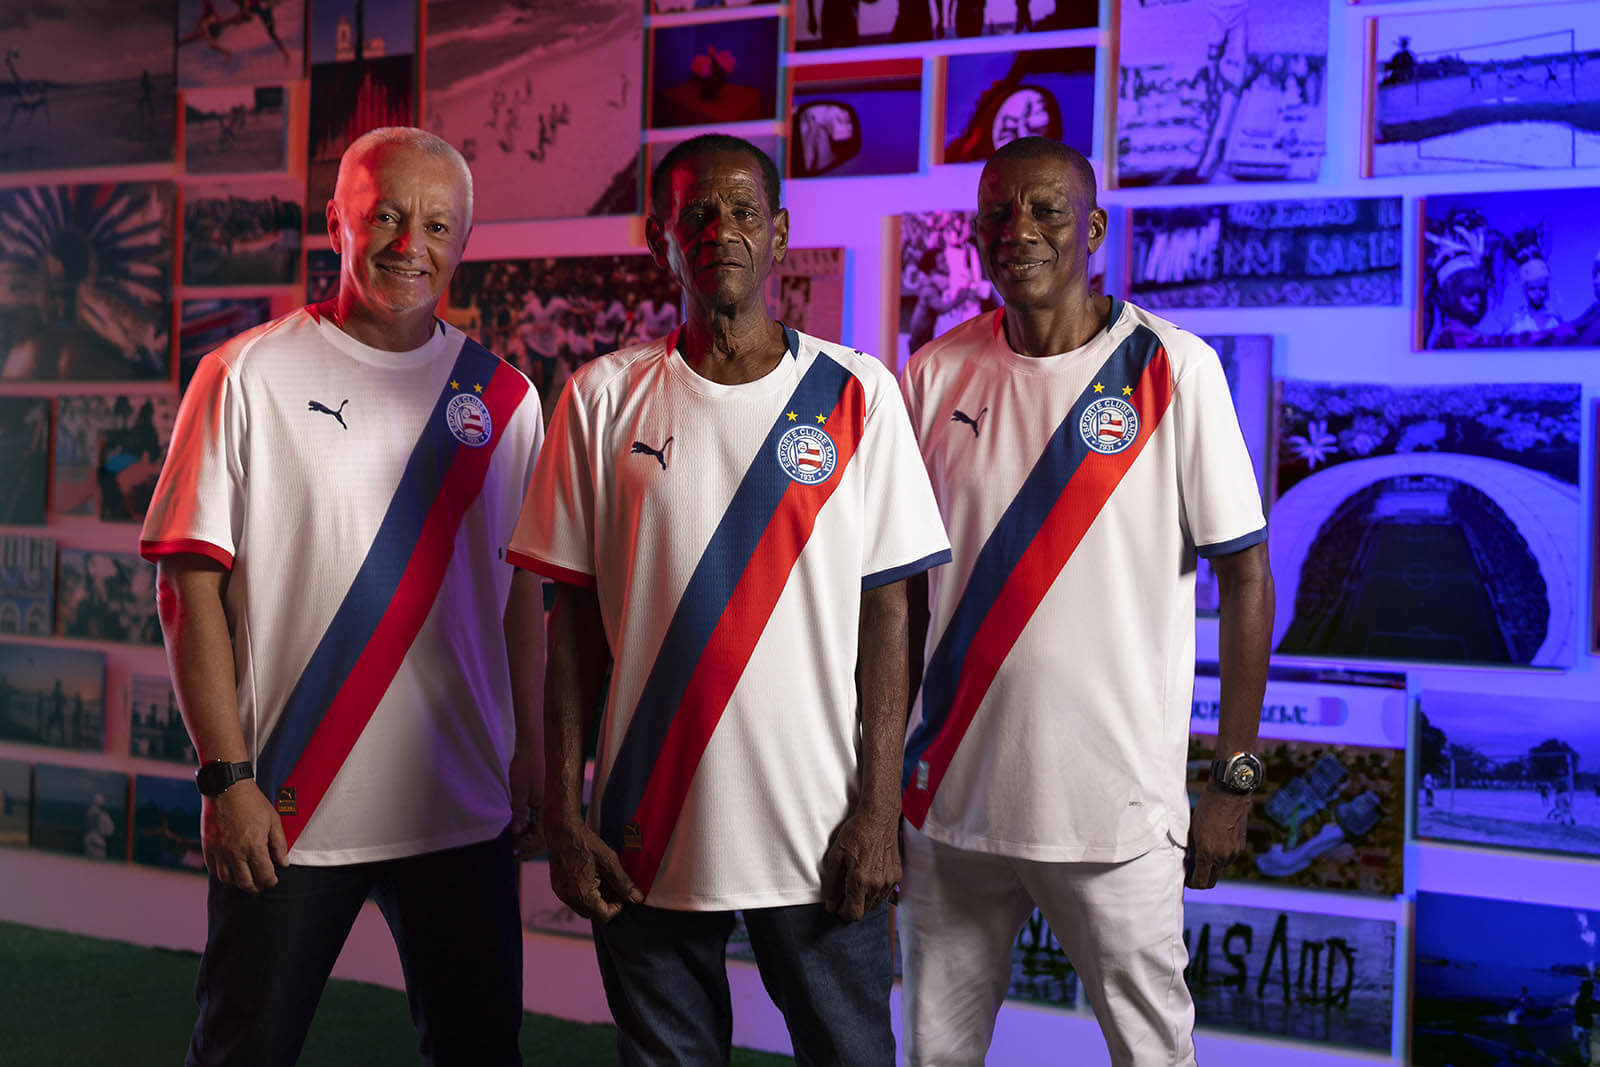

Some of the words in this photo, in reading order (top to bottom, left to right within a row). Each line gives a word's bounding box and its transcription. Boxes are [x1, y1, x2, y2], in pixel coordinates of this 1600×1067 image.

[1083, 402, 1102, 439] ESPORTE
[1104, 400, 1131, 416] CLUBE
[1123, 416, 1136, 441] BAHIA
[781, 430, 799, 468] ESPORTE
[799, 428, 828, 445] CLUBE
[824, 446, 834, 472] BAHIA
